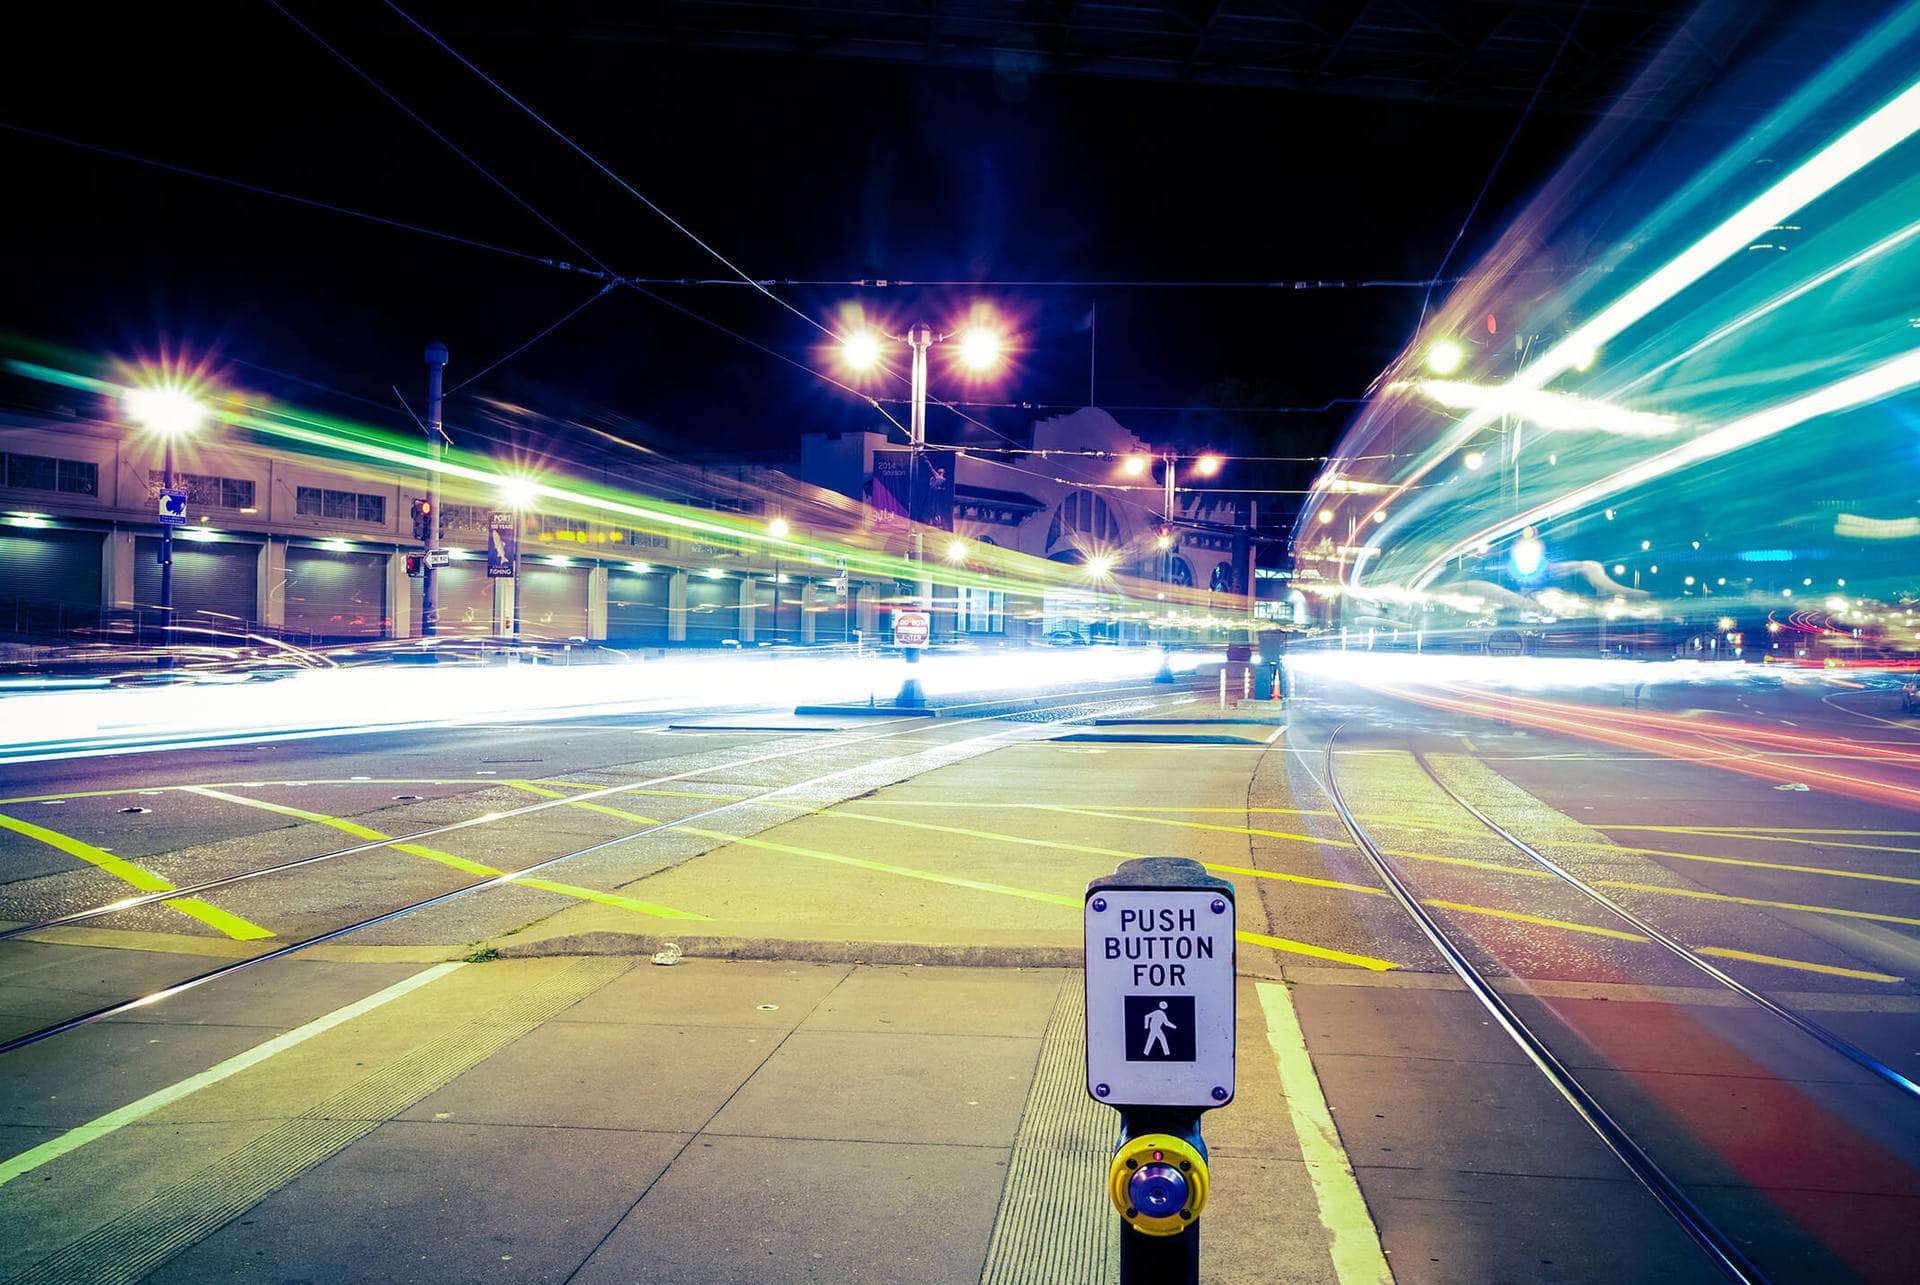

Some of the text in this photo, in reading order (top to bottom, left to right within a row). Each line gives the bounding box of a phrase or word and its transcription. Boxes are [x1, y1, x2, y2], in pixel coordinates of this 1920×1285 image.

[878, 462, 896, 470] 2014
[493, 513, 512, 522] PORT
[900, 634, 922, 642] ENTER
[1120, 908, 1196, 932] PUSH
[1104, 935, 1213, 960] BUTTON
[1133, 963, 1186, 987] FOR
